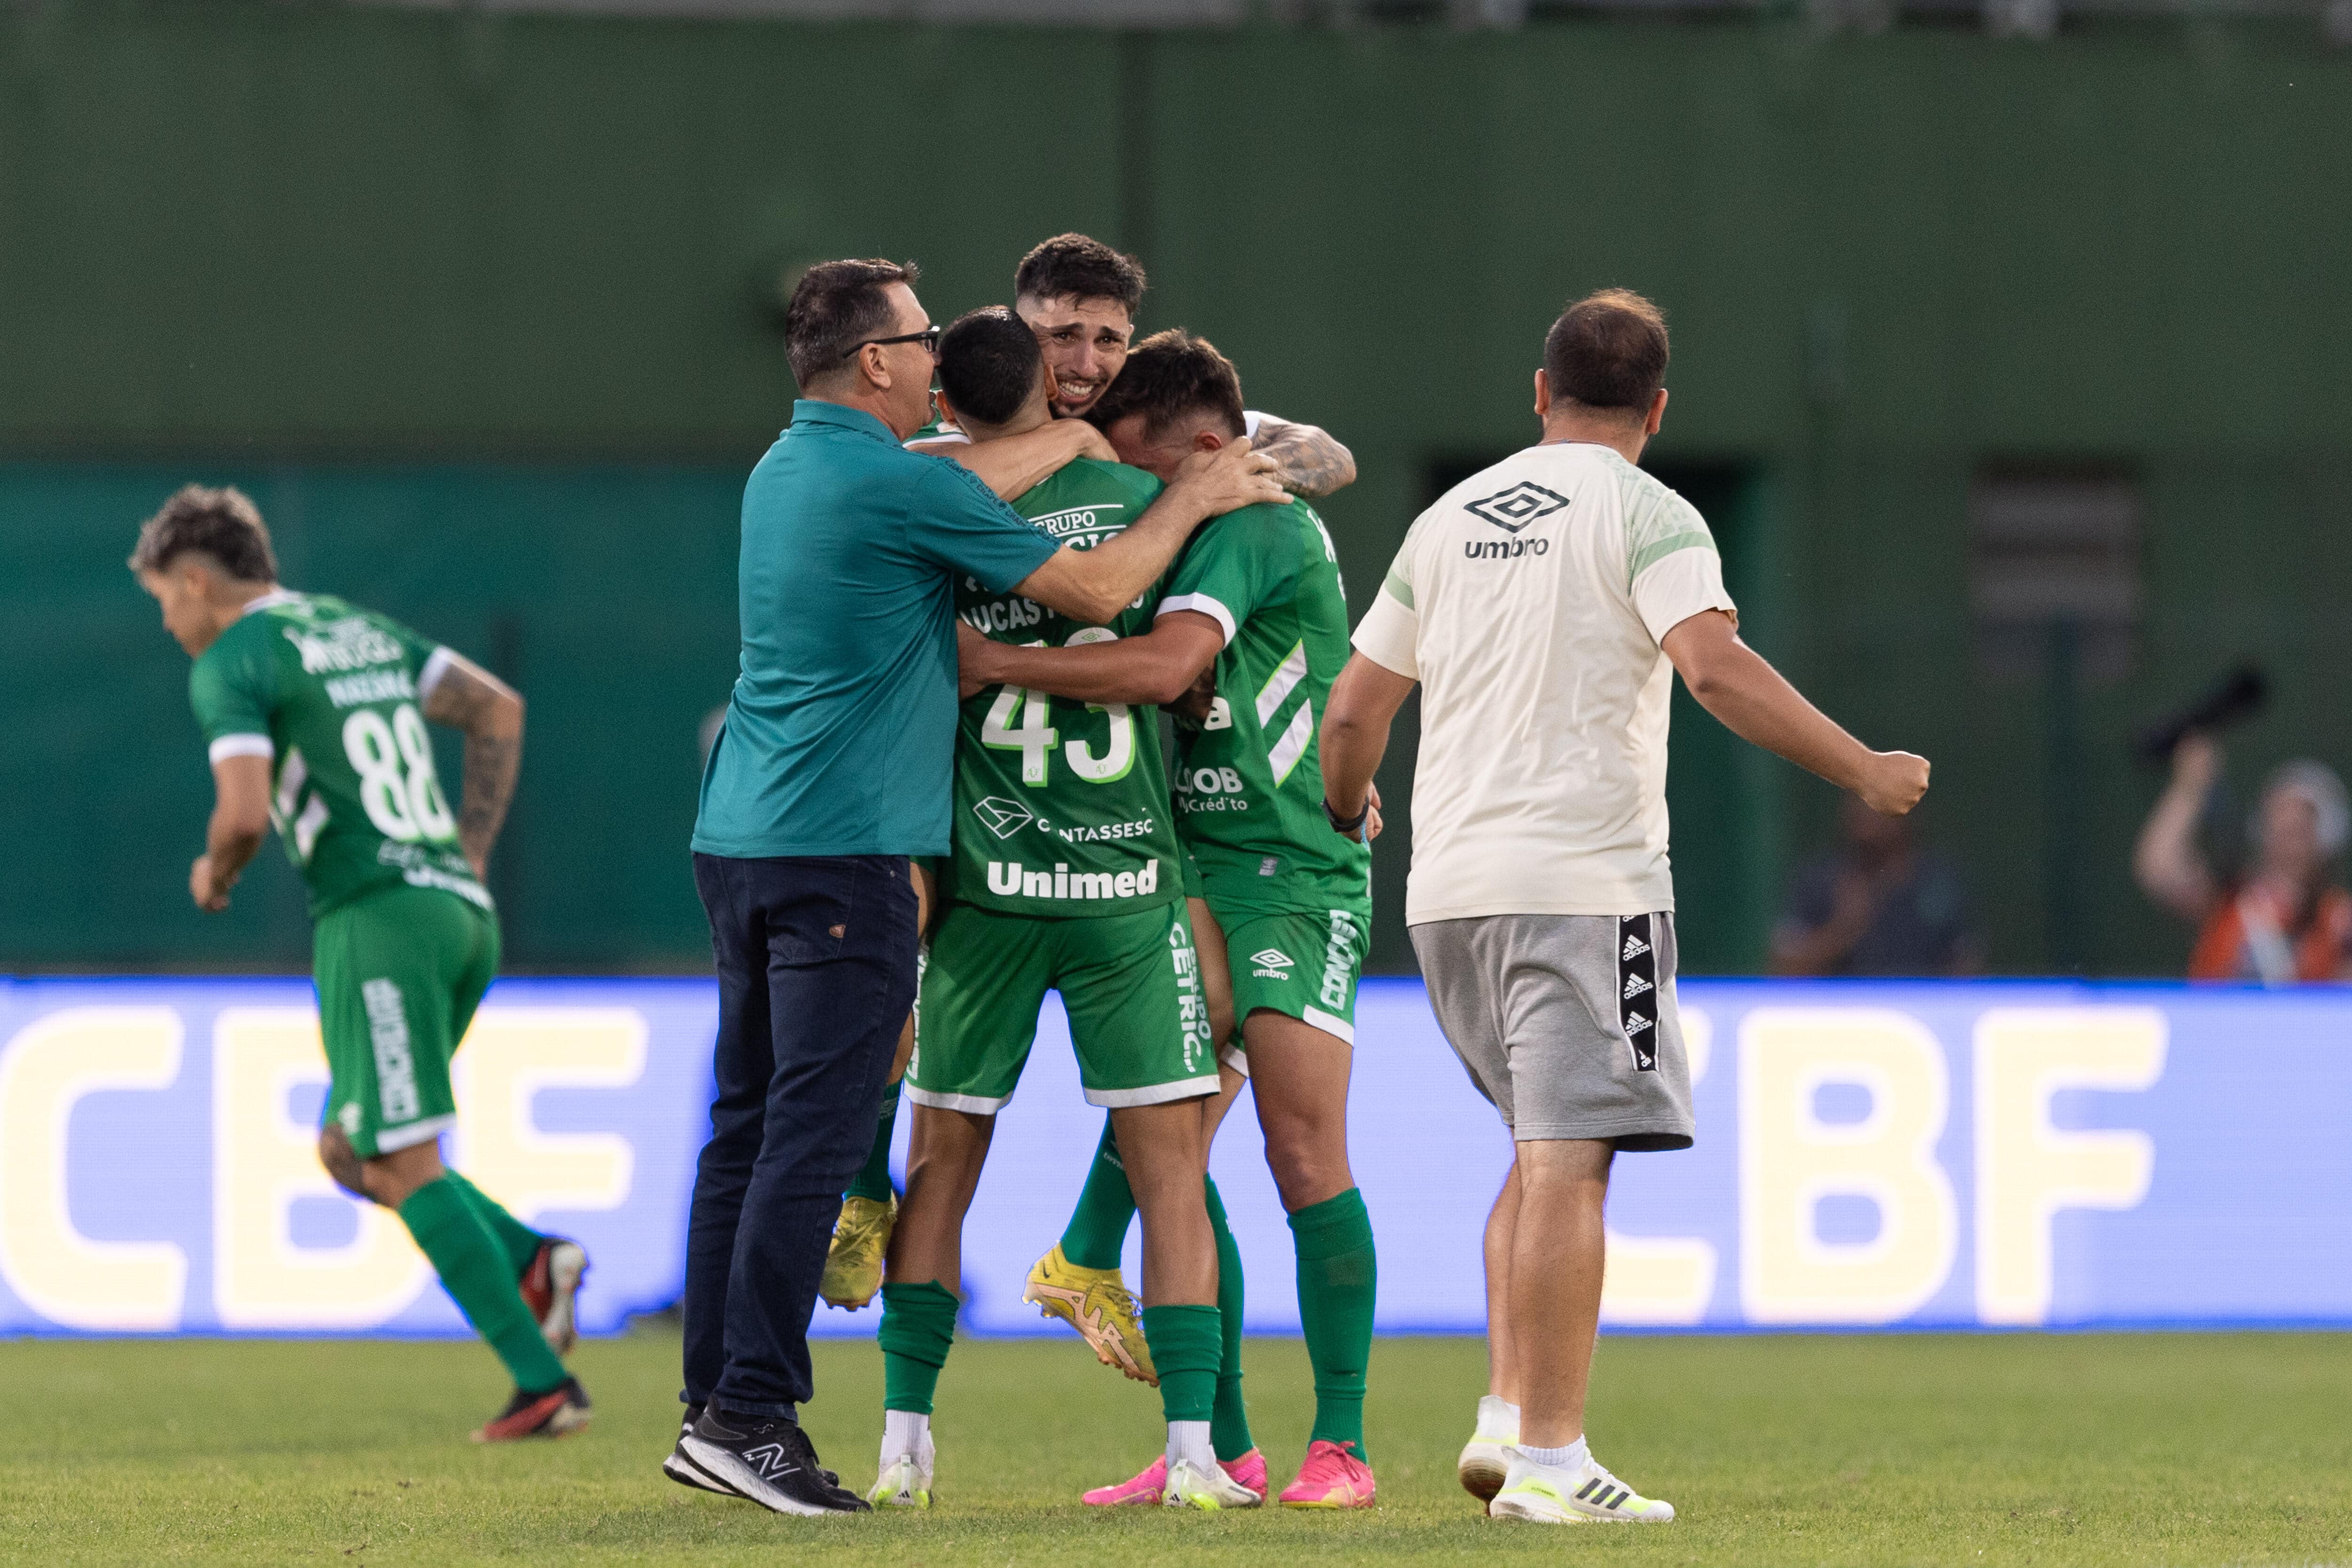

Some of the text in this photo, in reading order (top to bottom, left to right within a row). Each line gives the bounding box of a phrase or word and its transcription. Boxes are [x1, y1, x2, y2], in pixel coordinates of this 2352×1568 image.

[976, 484, 998, 505] CHAPE
[1005, 509, 1026, 528] CHAP
[1464, 536, 1549, 559] umbro
[342, 704, 457, 842] 88
[1037, 818, 1153, 843] CNTASSESC
[987, 859, 1158, 899] Unimed
[1623, 944, 1651, 961] adidas
[1253, 968, 1289, 981] umbro
[1168, 922, 1201, 1073] CETRIC
[1624, 982, 1653, 999] adidas
[0, 1004, 649, 1329] CBF
